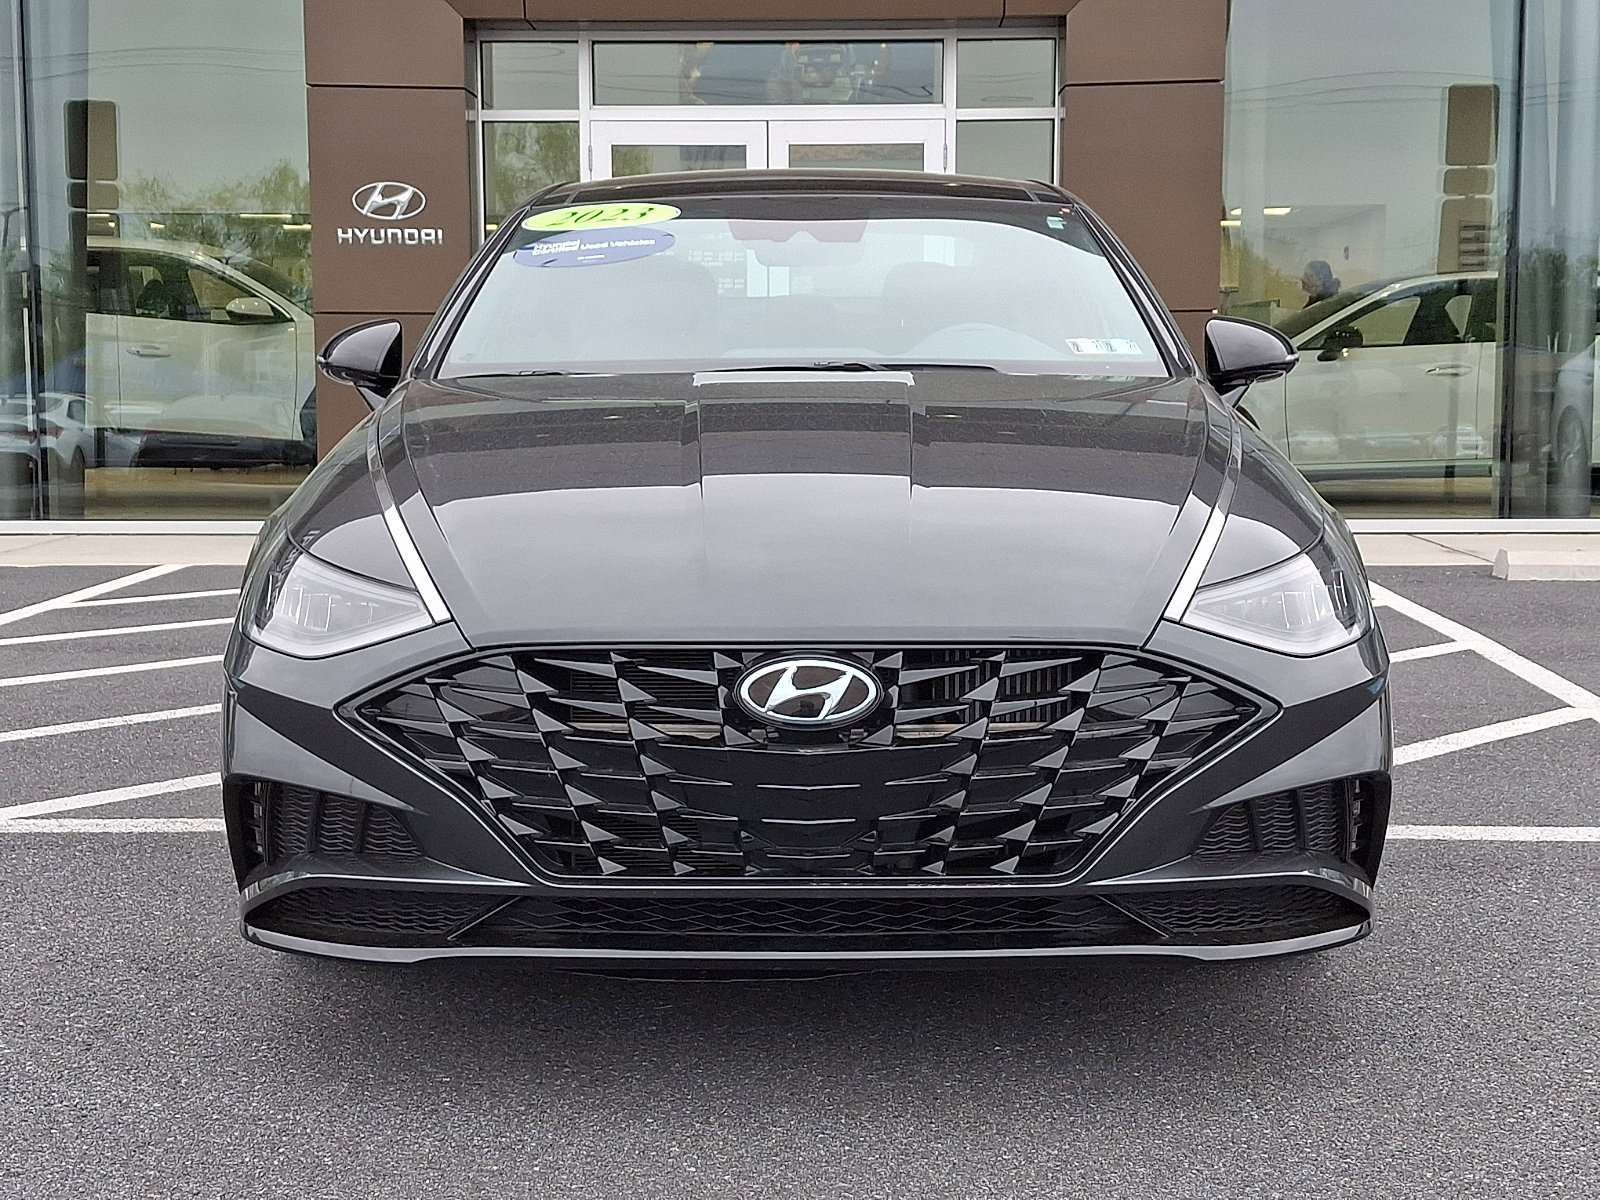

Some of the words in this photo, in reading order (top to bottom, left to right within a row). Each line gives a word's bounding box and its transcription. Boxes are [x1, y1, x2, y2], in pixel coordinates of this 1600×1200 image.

[546, 207, 655, 227] 2023
[337, 227, 443, 245] HYUNDAI
[581, 241, 608, 250] Used
[610, 239, 656, 248] Vehicles
